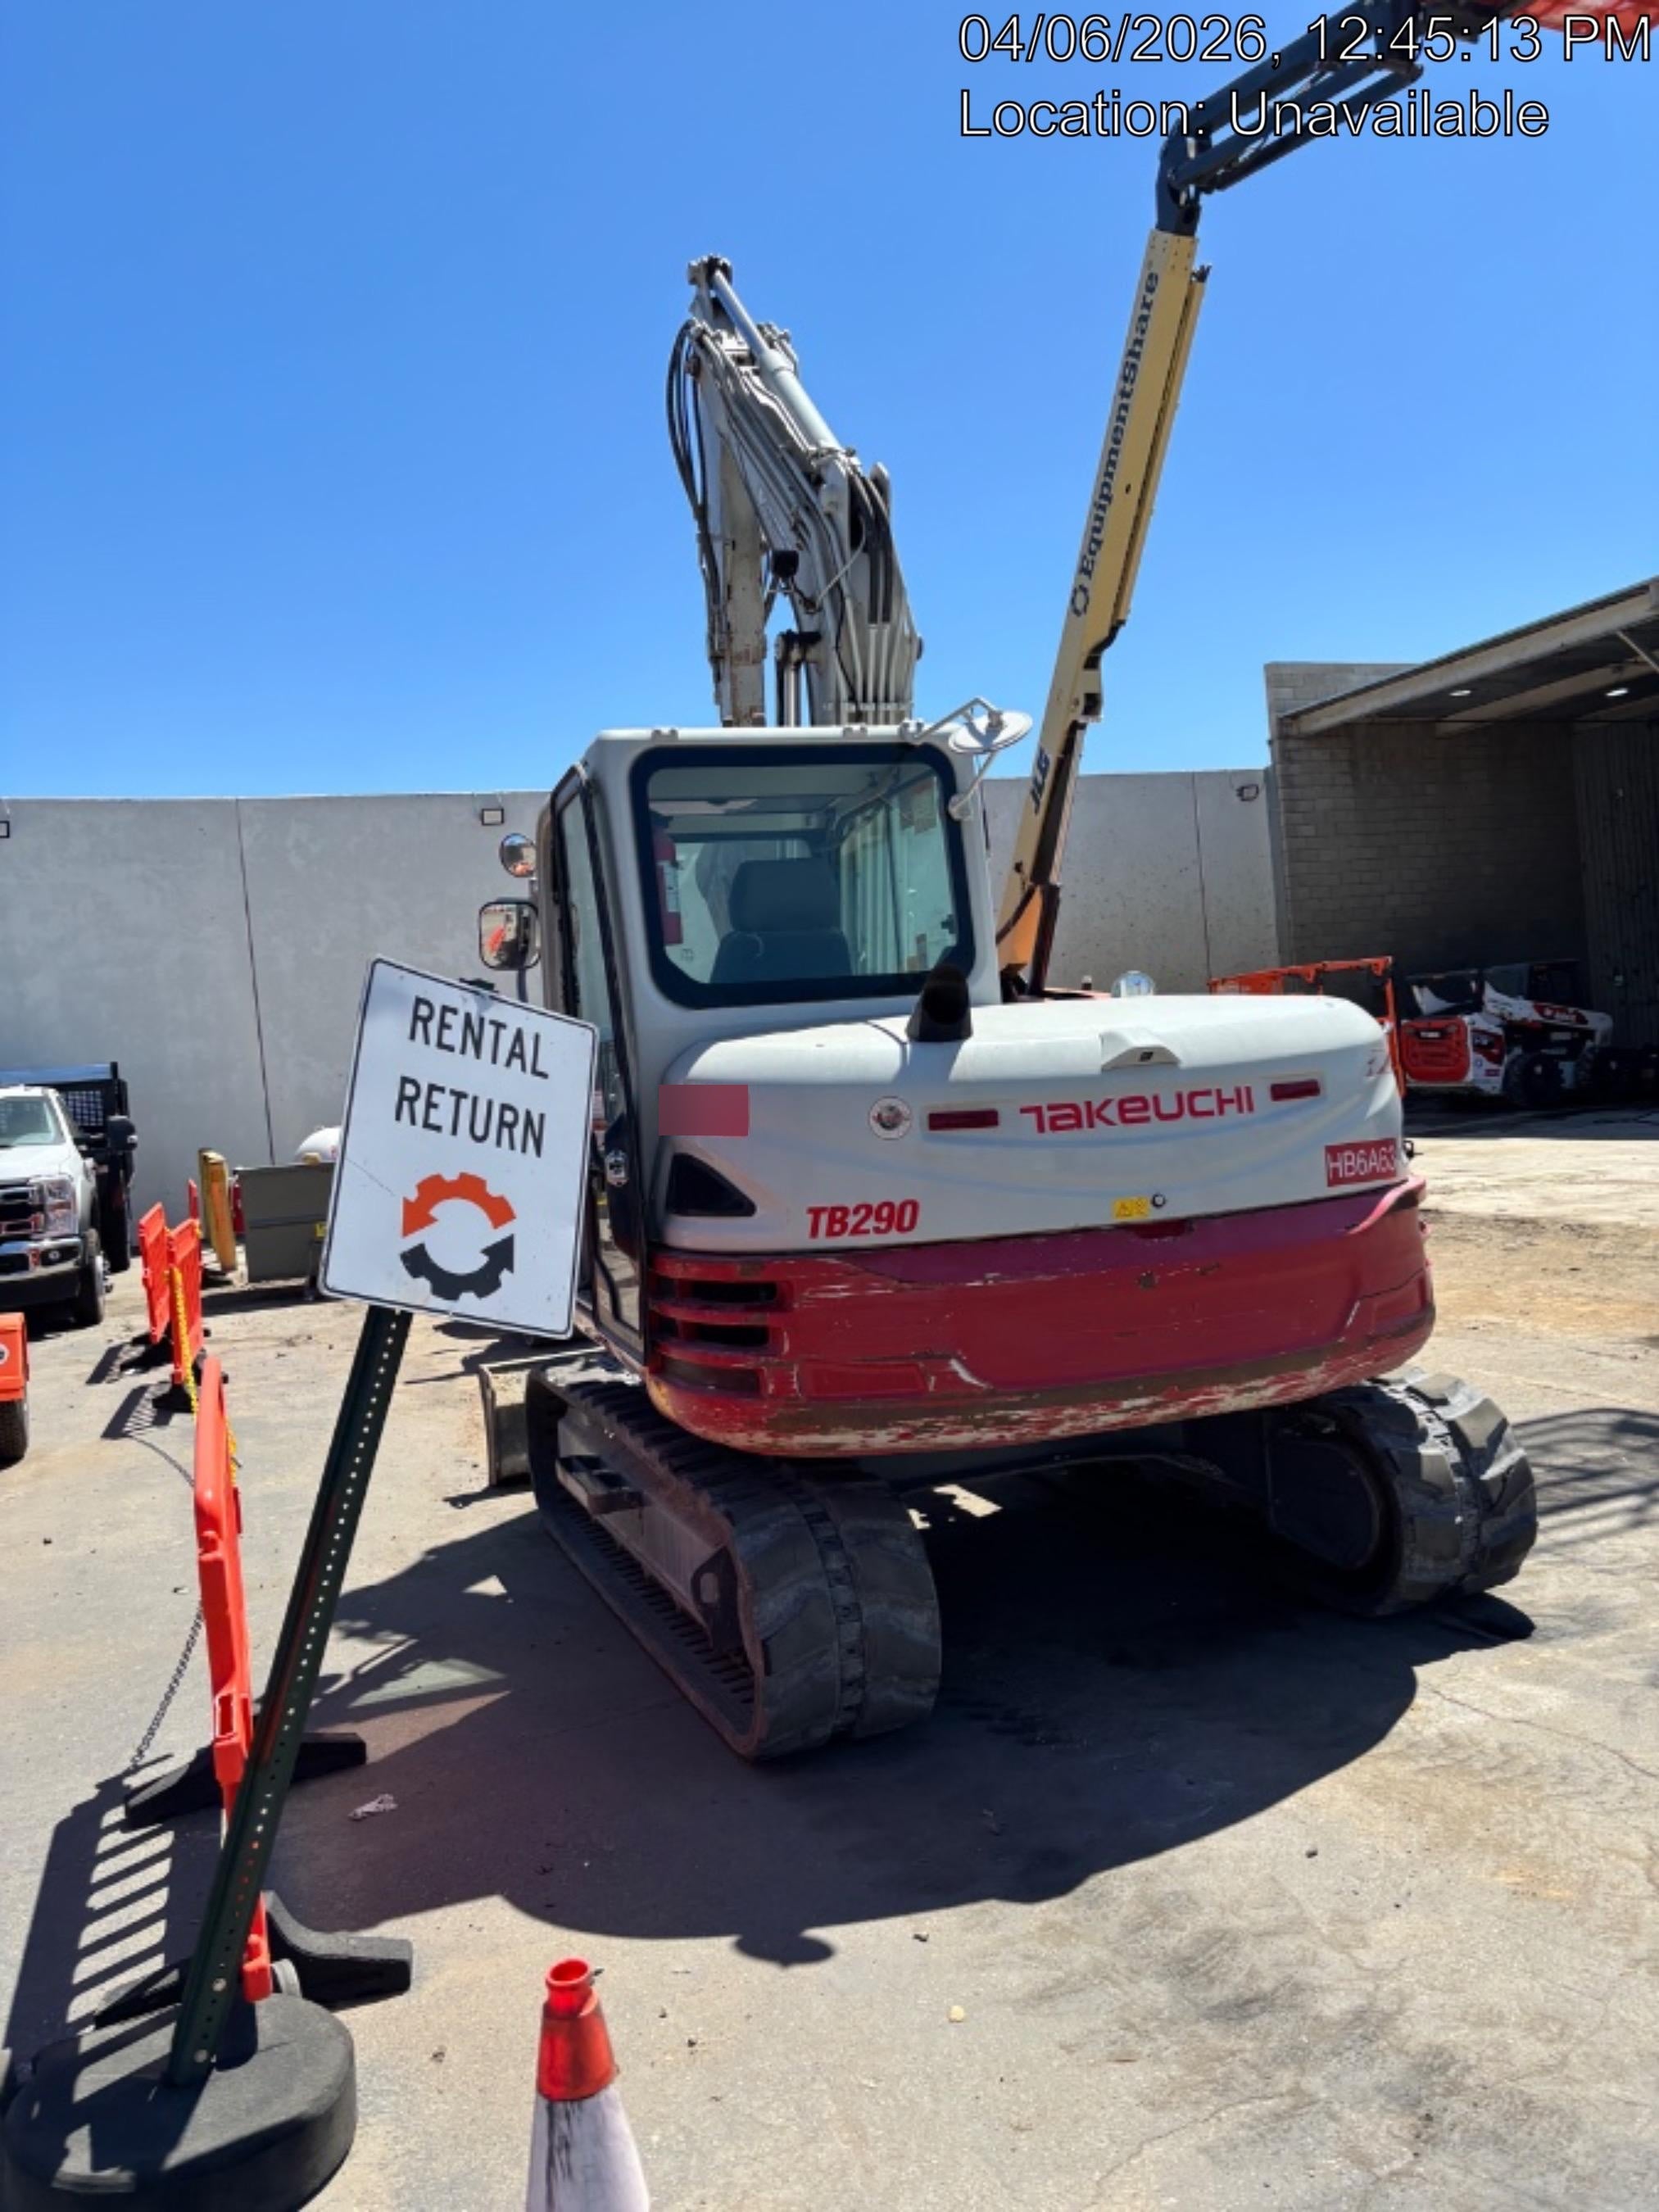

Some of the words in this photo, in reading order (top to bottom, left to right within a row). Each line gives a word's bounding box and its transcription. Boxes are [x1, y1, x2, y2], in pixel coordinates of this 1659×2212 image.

[1077, 271, 1158, 580] EquipmentShare
[408, 995, 549, 1079] RENTAL
[395, 1076, 546, 1158] RETURN
[806, 1199, 919, 1240] TB290
